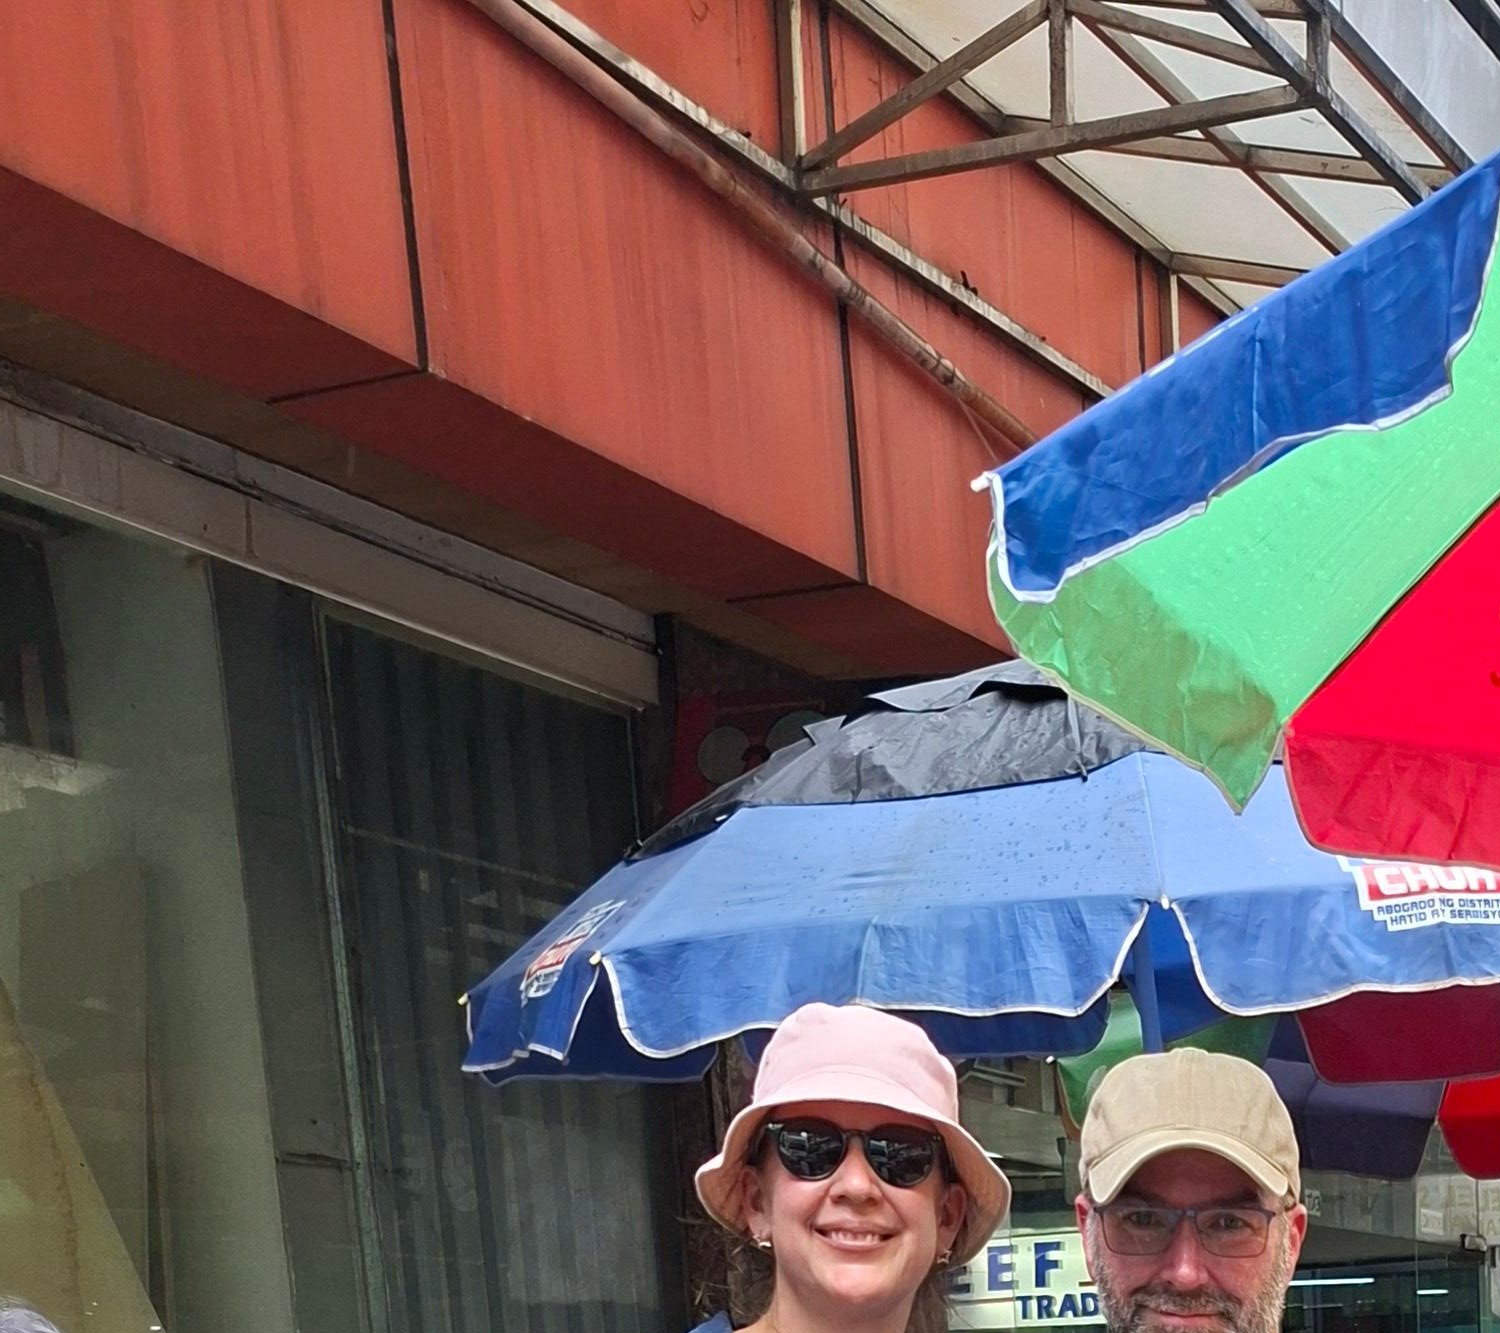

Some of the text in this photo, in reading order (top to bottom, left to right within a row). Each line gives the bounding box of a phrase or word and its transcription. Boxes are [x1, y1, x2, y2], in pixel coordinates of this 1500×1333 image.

[1377, 898, 1435, 915] ABOGADO
[1438, 897, 1454, 908] NG
[1390, 911, 1427, 926] HATID
